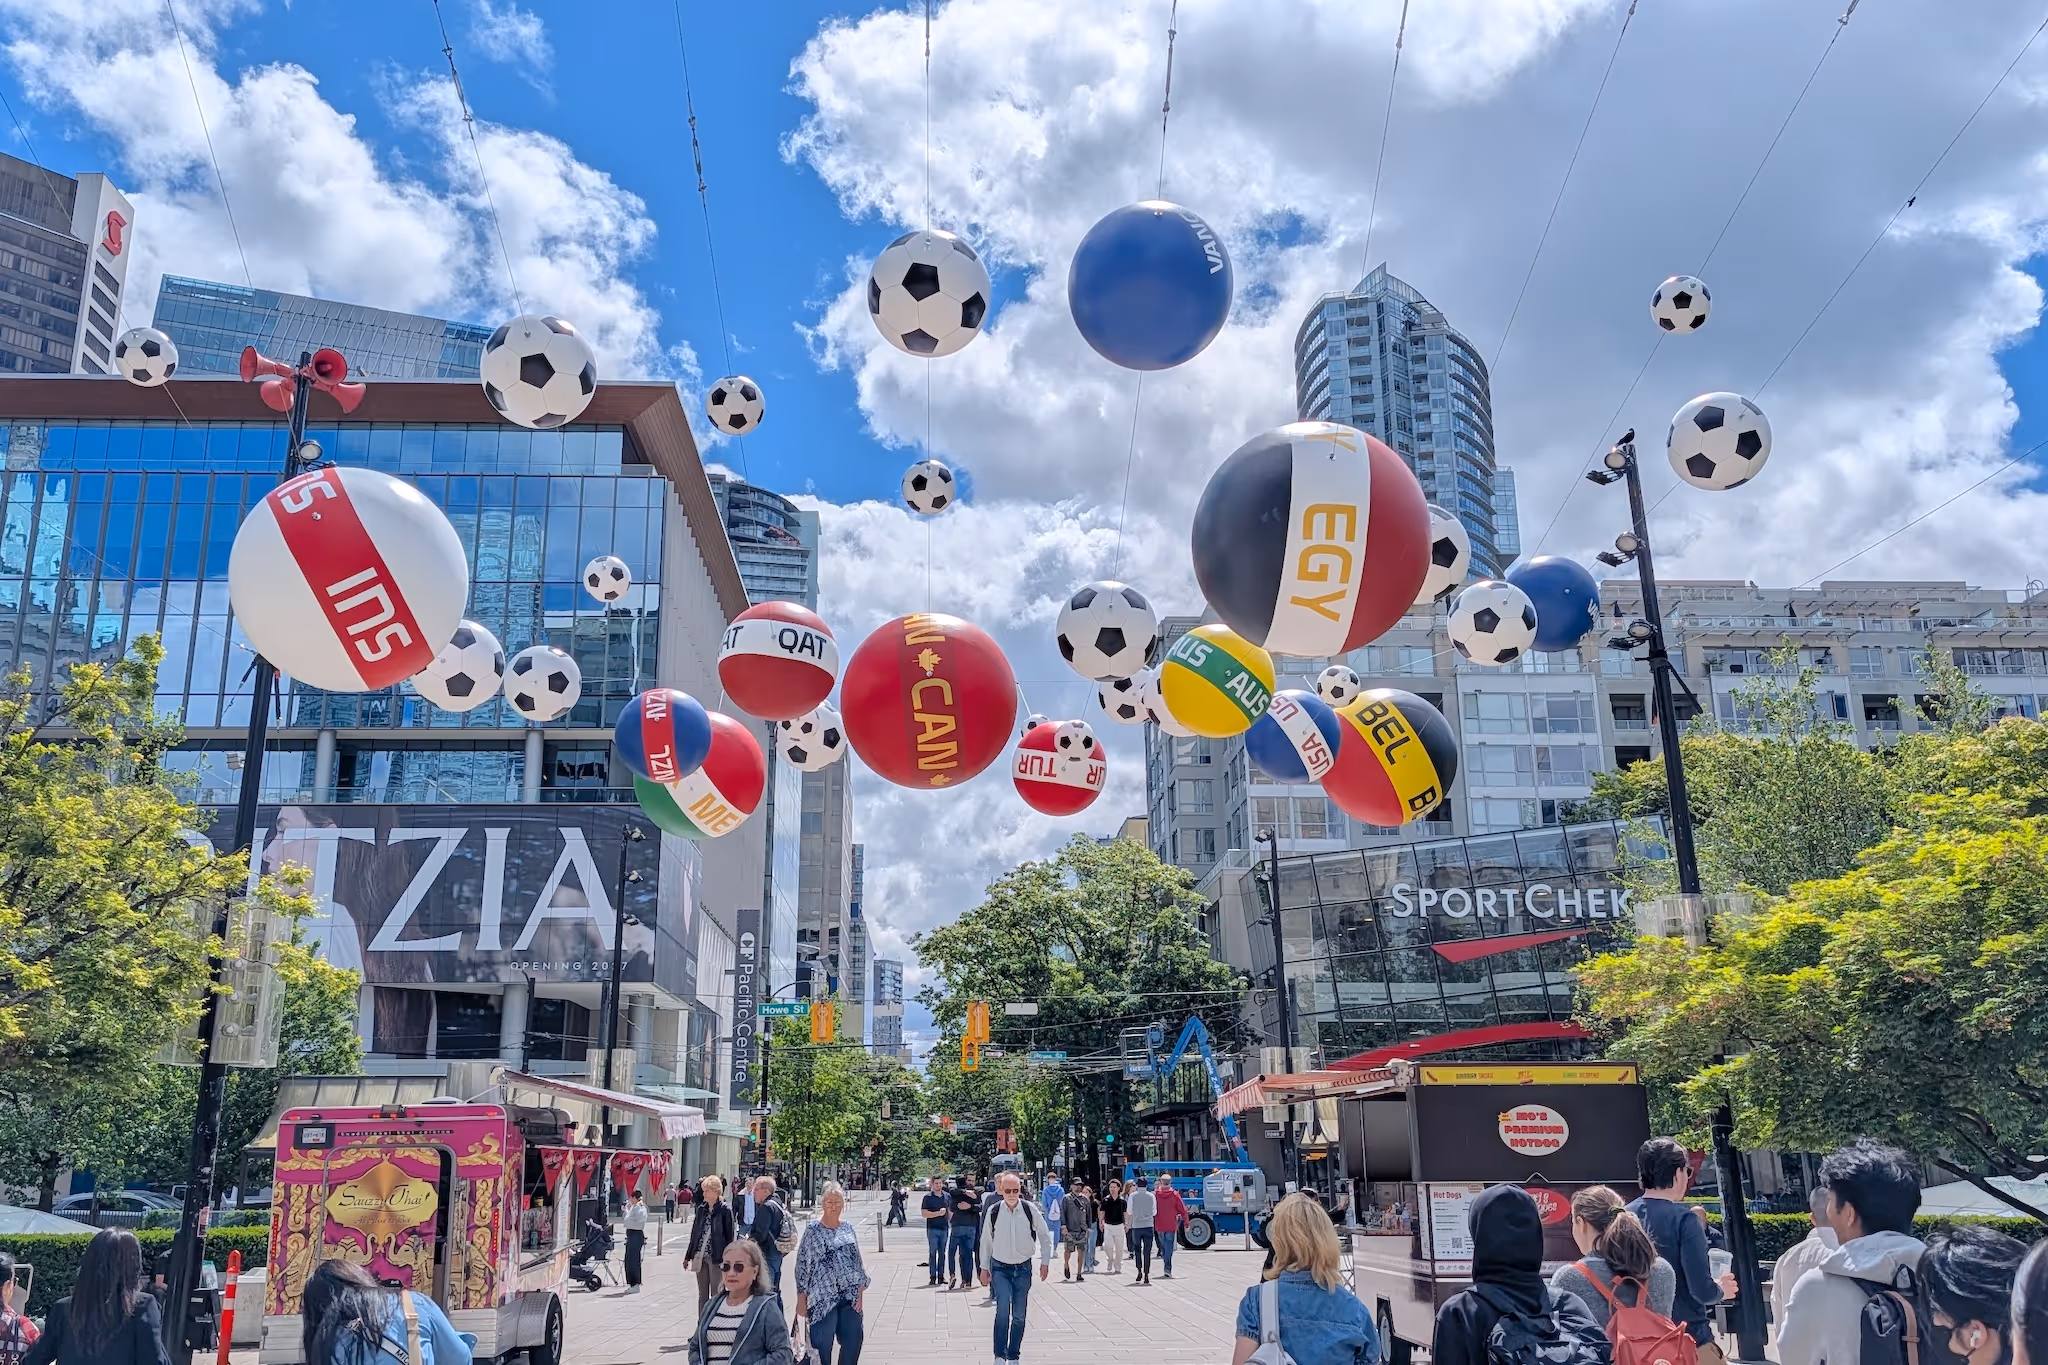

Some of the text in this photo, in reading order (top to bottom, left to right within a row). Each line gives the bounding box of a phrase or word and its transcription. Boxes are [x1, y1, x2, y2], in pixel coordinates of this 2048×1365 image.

[1290, 503, 1357, 623] EGY
[325, 566, 413, 663] SUI
[778, 627, 827, 660] QAT
[1224, 669, 1271, 718] AUS
[910, 678, 958, 771] CAN
[1355, 700, 1411, 766] BEL
[649, 744, 676, 782] NZL
[1018, 753, 1057, 778] TUR
[1301, 732, 1330, 777] USA
[688, 792, 742, 833] ME
[510, 961, 629, 971] OPENING 207
[737, 963, 754, 1018] Pacific
[762, 1004, 805, 1015] Howe St
[735, 1024, 752, 1083] Centre
[1504, 1125, 1564, 1135] PREMIUM
[1516, 1112, 1548, 1121] MO'S
[1510, 1138, 1561, 1148] HOTDOG
[338, 1184, 387, 1208] Sauzzy
[1433, 1191, 1462, 1200] Hot Dogs
